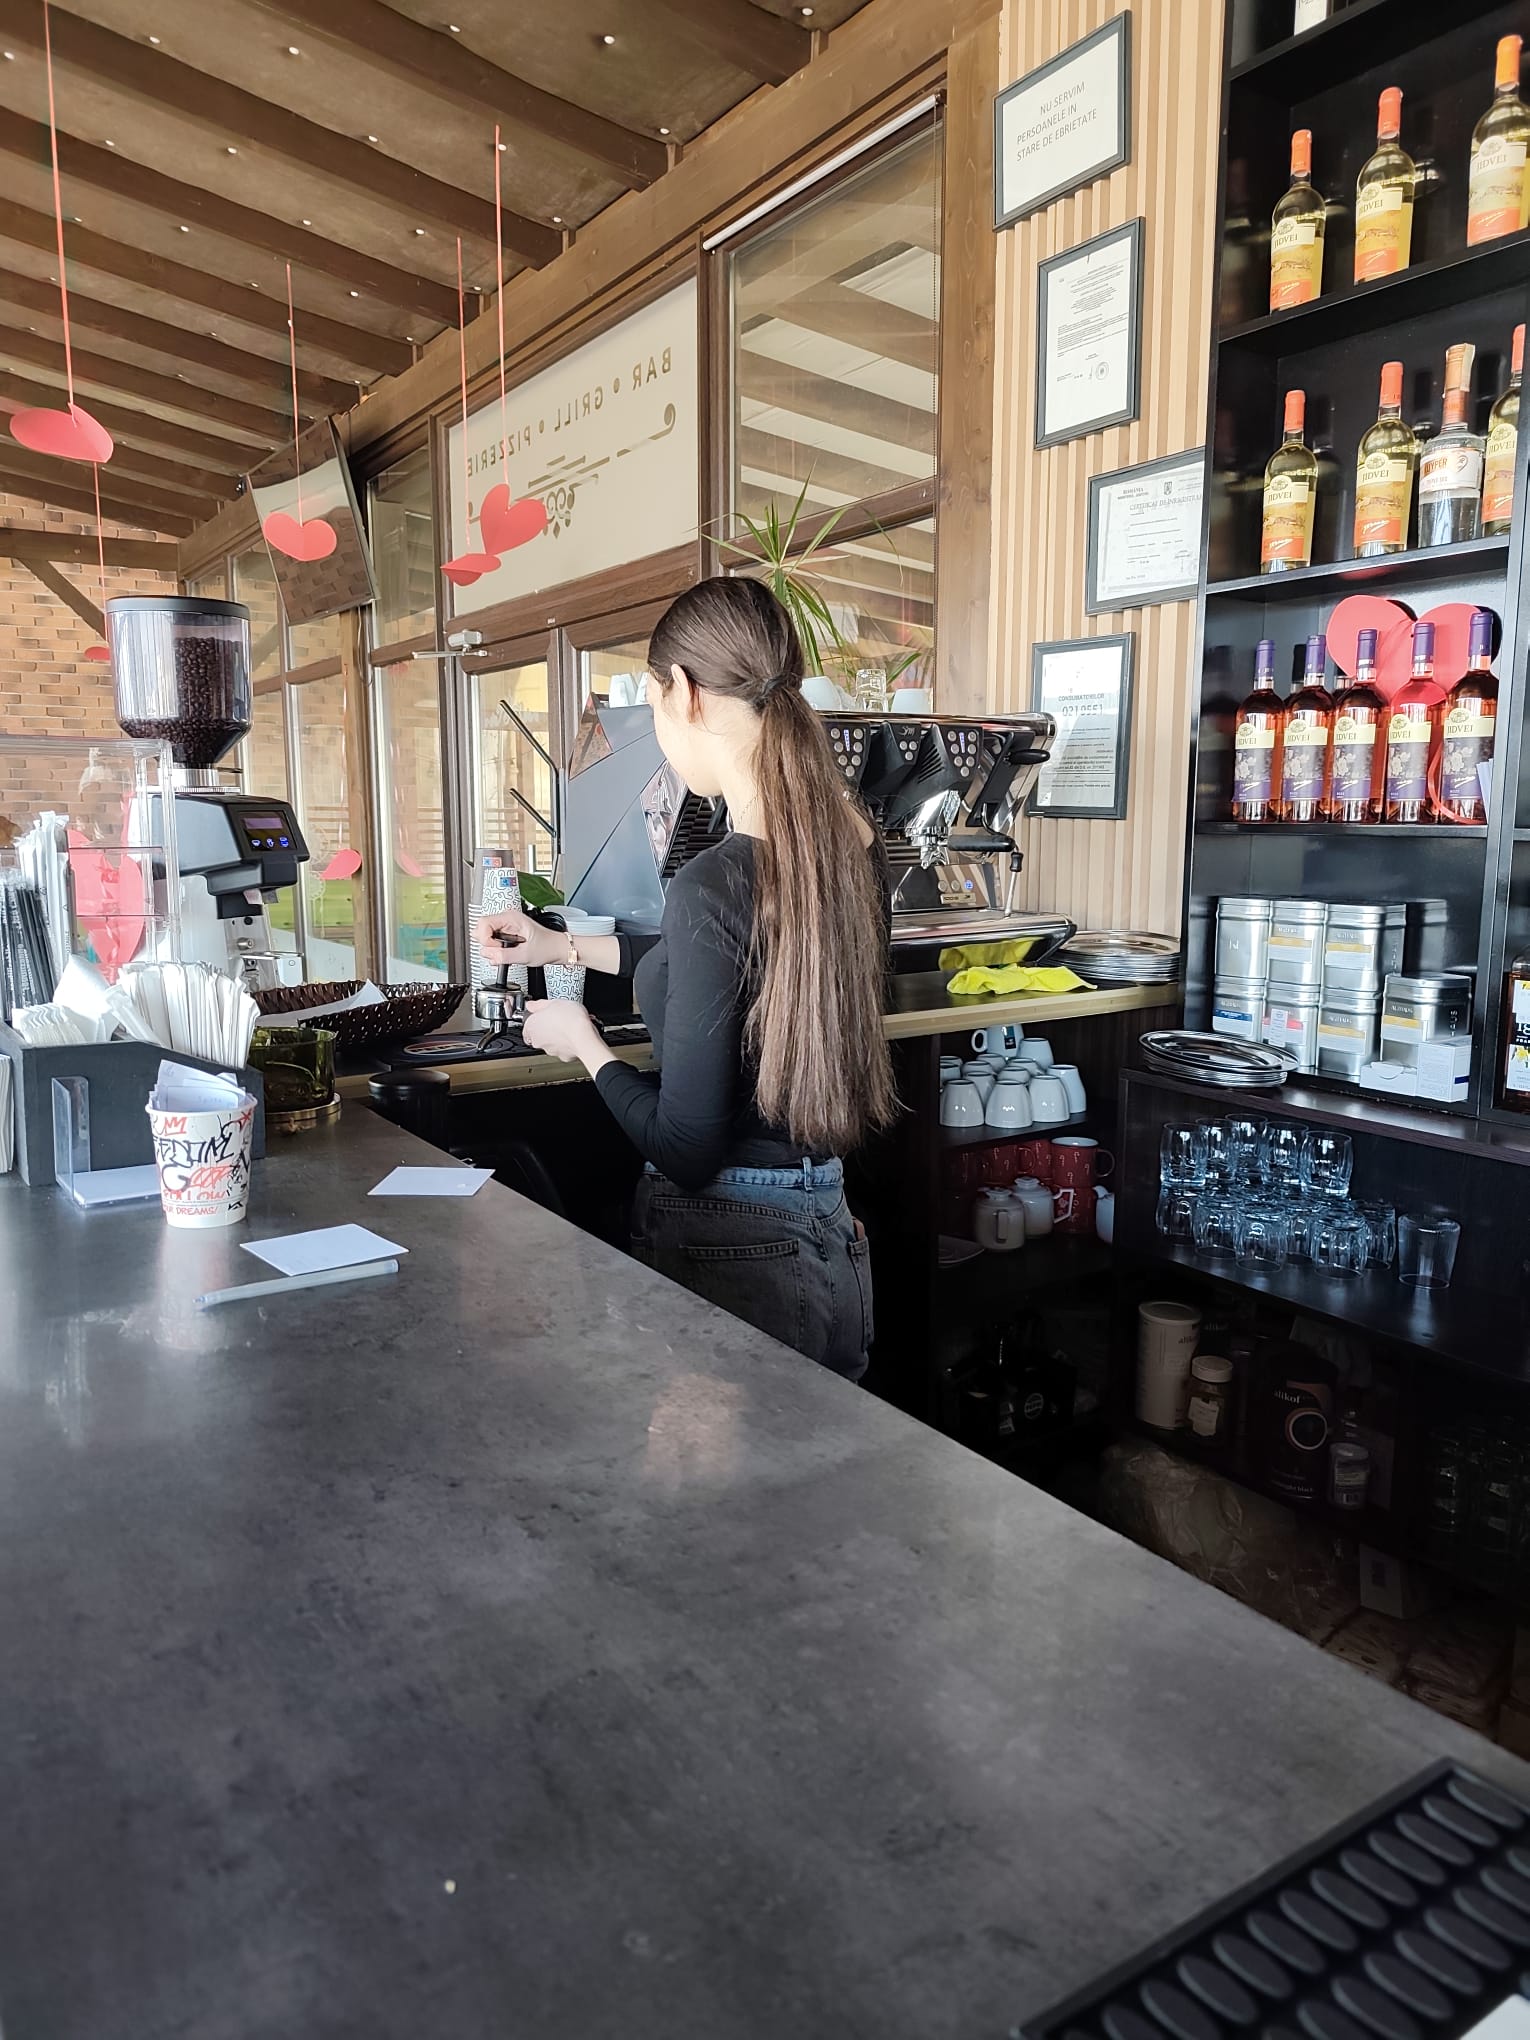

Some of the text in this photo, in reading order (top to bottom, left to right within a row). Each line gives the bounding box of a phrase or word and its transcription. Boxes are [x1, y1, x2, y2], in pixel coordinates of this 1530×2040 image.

[1040, 81, 1085, 116] NU SERVIM
[1016, 108, 1097, 162] STARE DE EBRIETATE
[1017, 108, 1065, 145] PERSOANELE
[1274, 234, 1298, 248] JIDVEI
[1362, 469, 1389, 483] JIDVEI
[1268, 491, 1292, 504] JIDVEI
